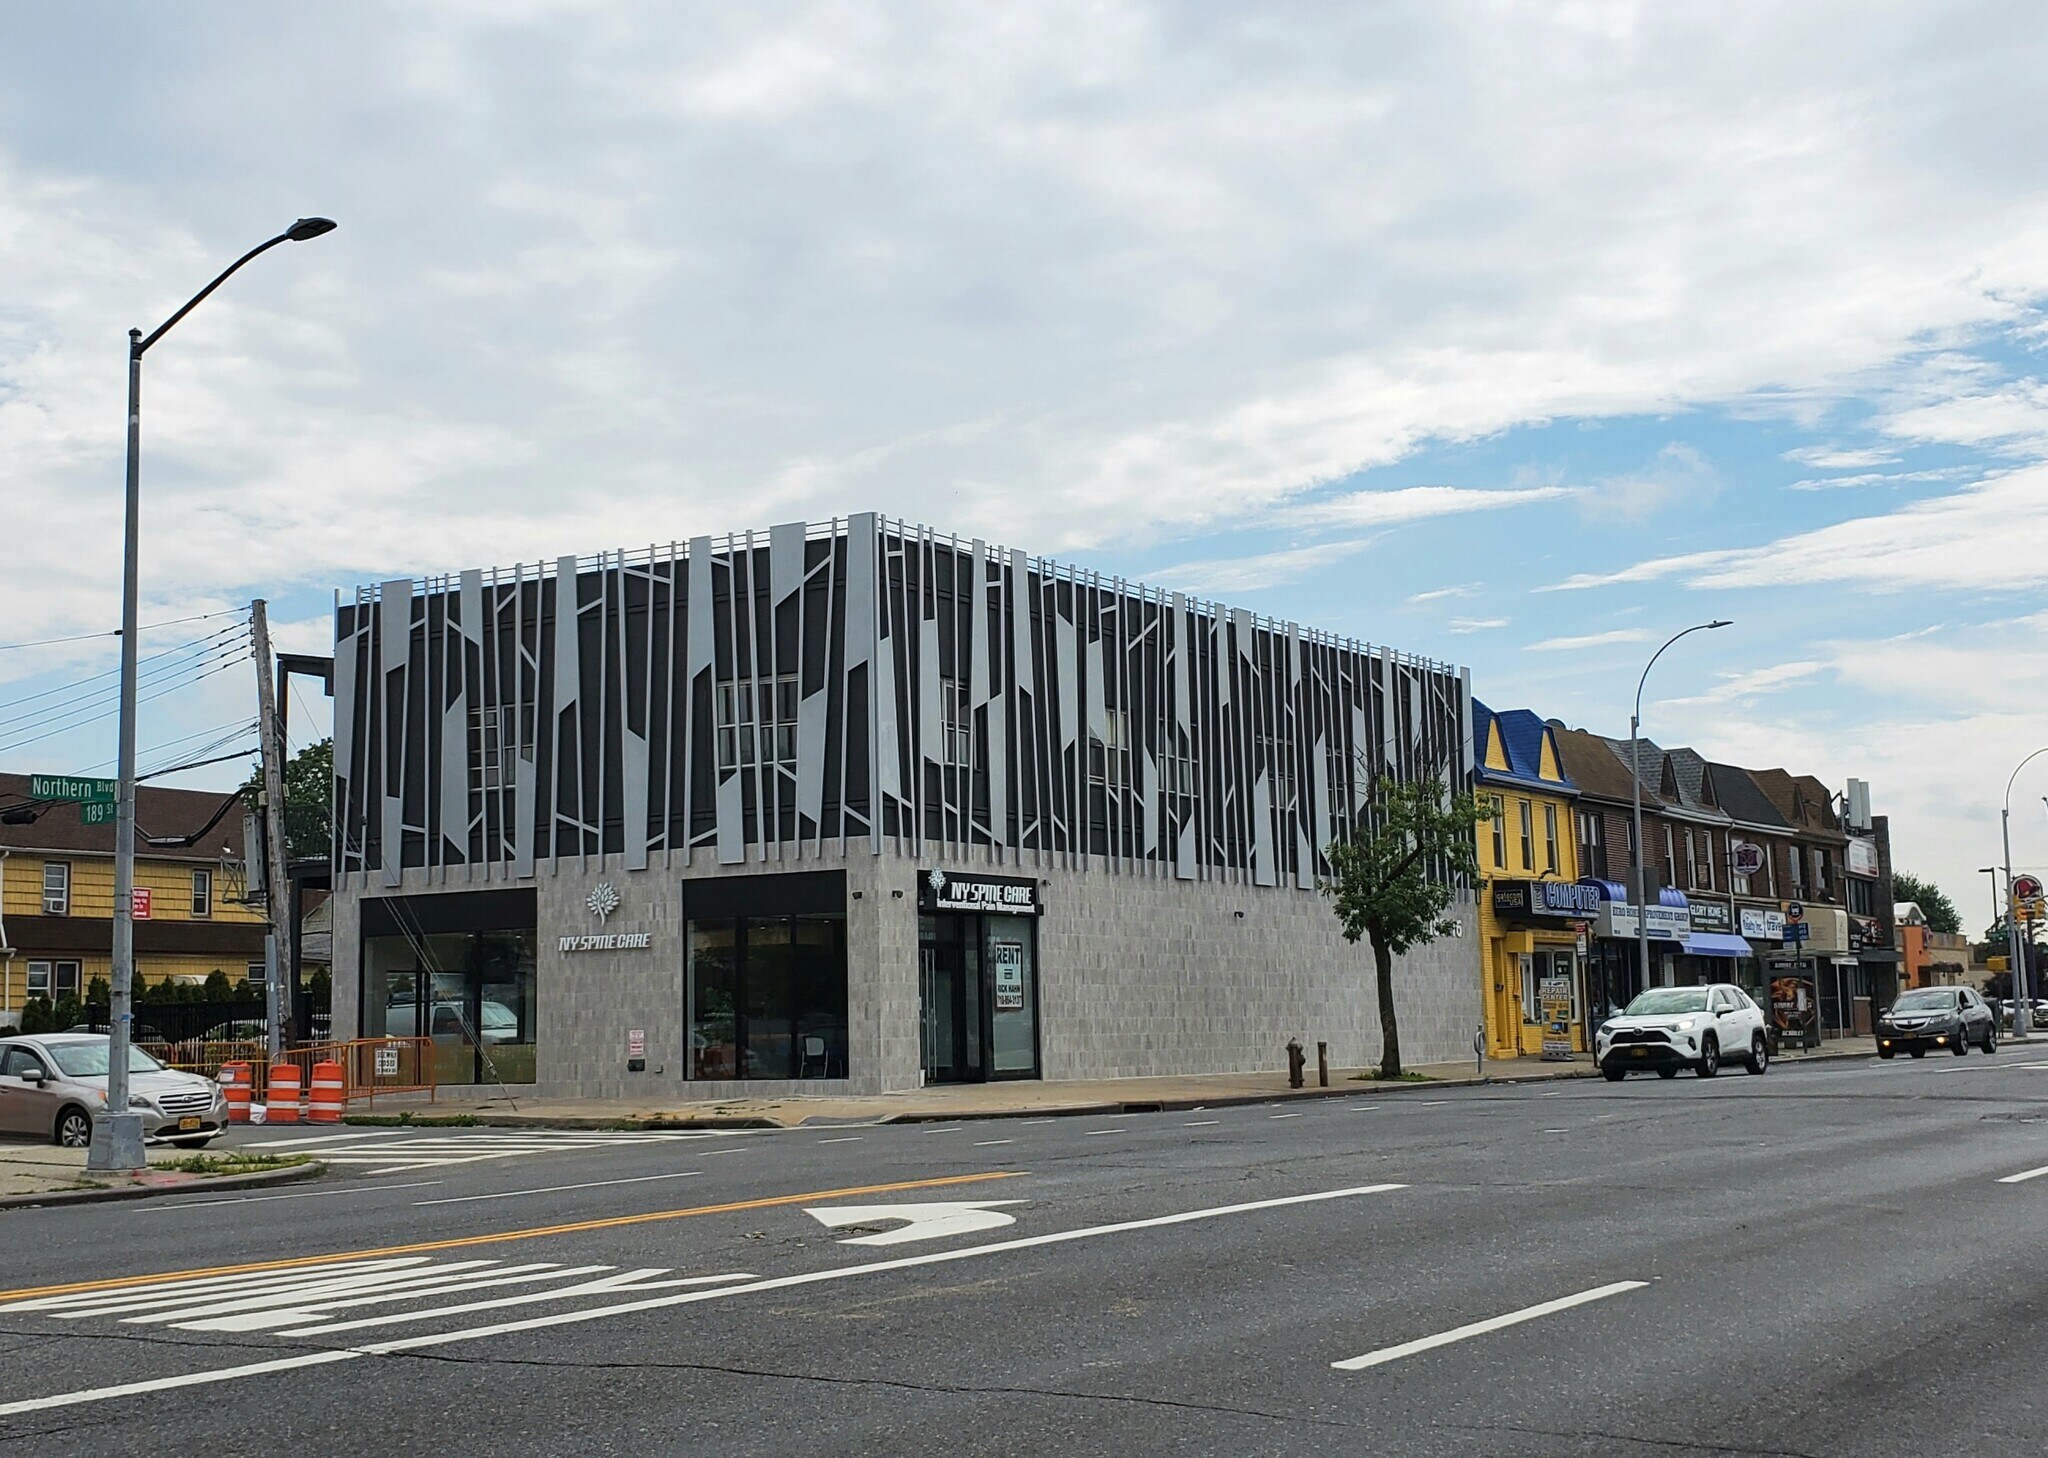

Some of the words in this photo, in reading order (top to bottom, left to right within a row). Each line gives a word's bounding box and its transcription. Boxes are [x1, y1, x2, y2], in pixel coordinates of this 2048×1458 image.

[33, 777, 92, 798] Northern
[97, 780, 114, 793] Blvd
[87, 804, 104, 822] 189
[106, 803, 114, 815] St
[951, 882, 971, 900] NY
[970, 883, 1004, 902] SPINE
[1004, 885, 1033, 904] CARE
[1546, 882, 1601, 910] COMPUTER
[1690, 904, 1707, 917] GLORY
[1707, 906, 1723, 918] HOME
[559, 936, 580, 952] NY
[579, 934, 618, 951] SPINE
[617, 932, 652, 949] CARE
[996, 947, 1021, 965] RENT
[1542, 987, 1568, 995] REPAIR
[0, 1256, 762, 1338] ONLY
